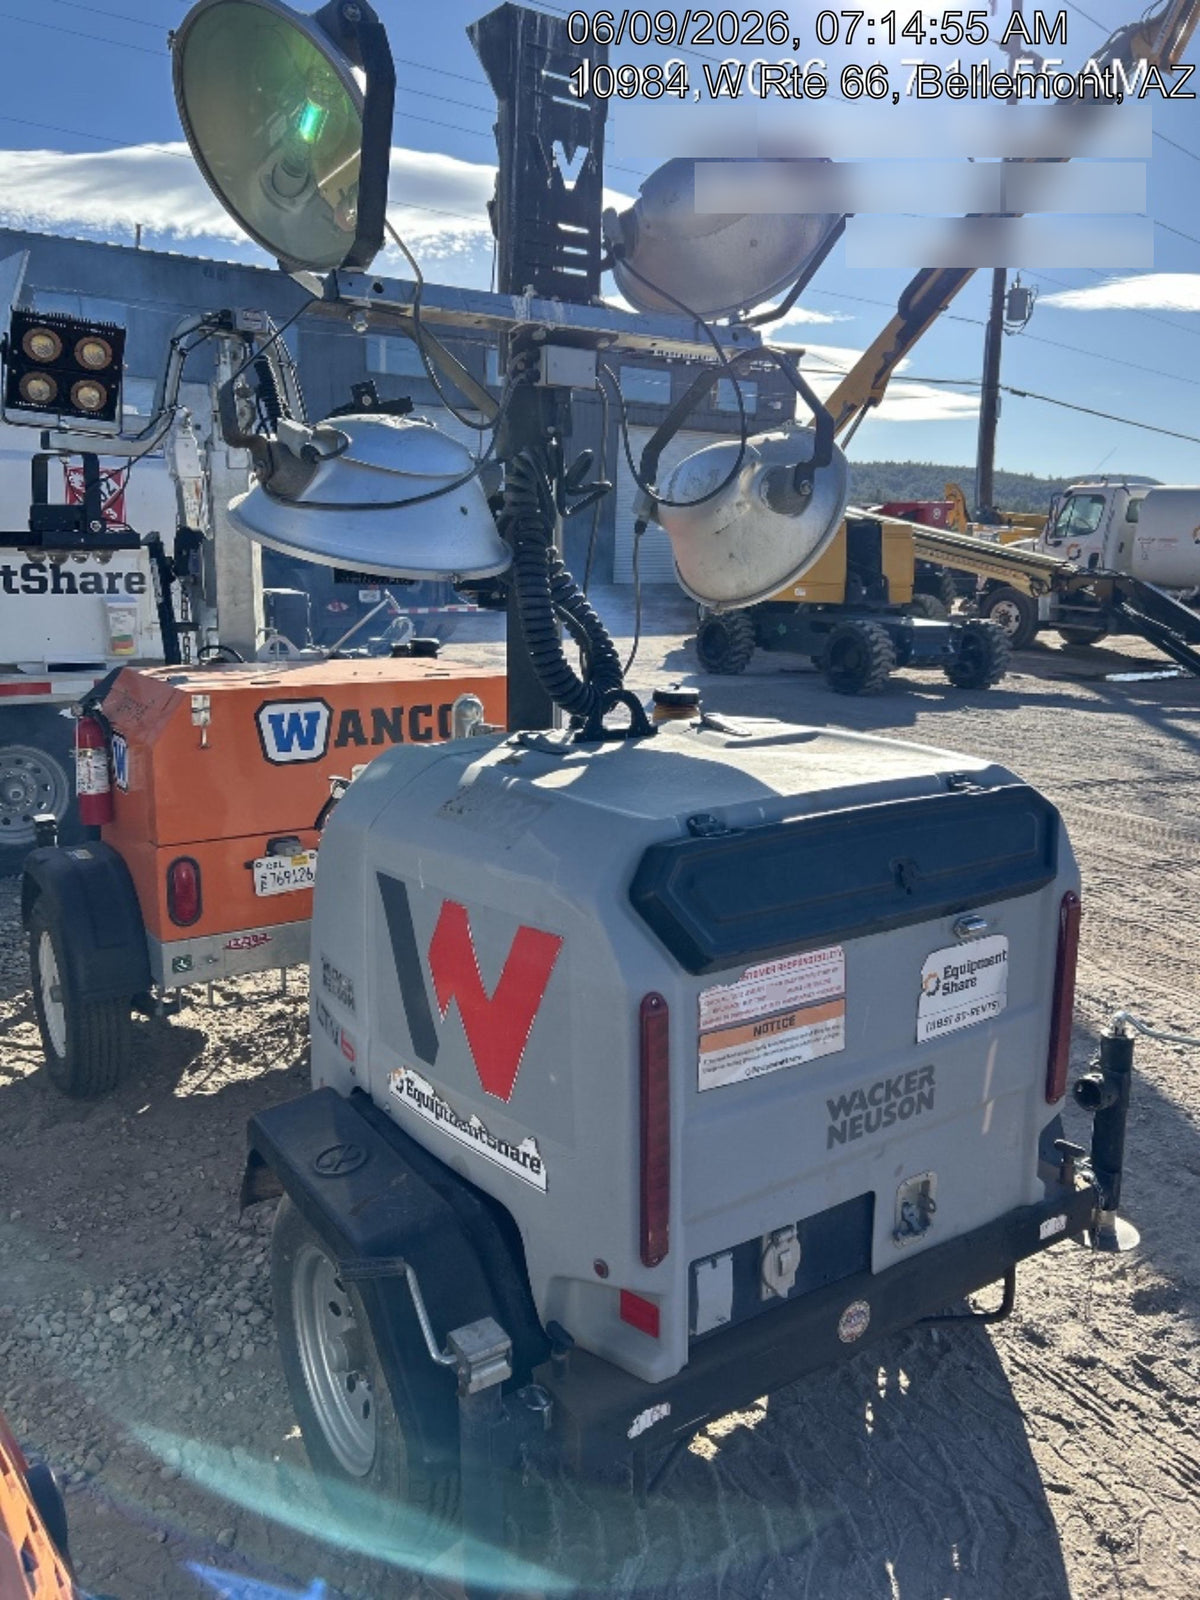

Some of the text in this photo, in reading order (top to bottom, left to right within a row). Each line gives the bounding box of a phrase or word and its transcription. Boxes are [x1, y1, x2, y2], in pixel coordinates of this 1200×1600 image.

[942, 949, 1007, 996] Equipment Share
[753, 1015, 796, 1037] NOTICE
[826, 1064, 936, 1122] WACKER
[826, 1087, 934, 1150] NEUSON
